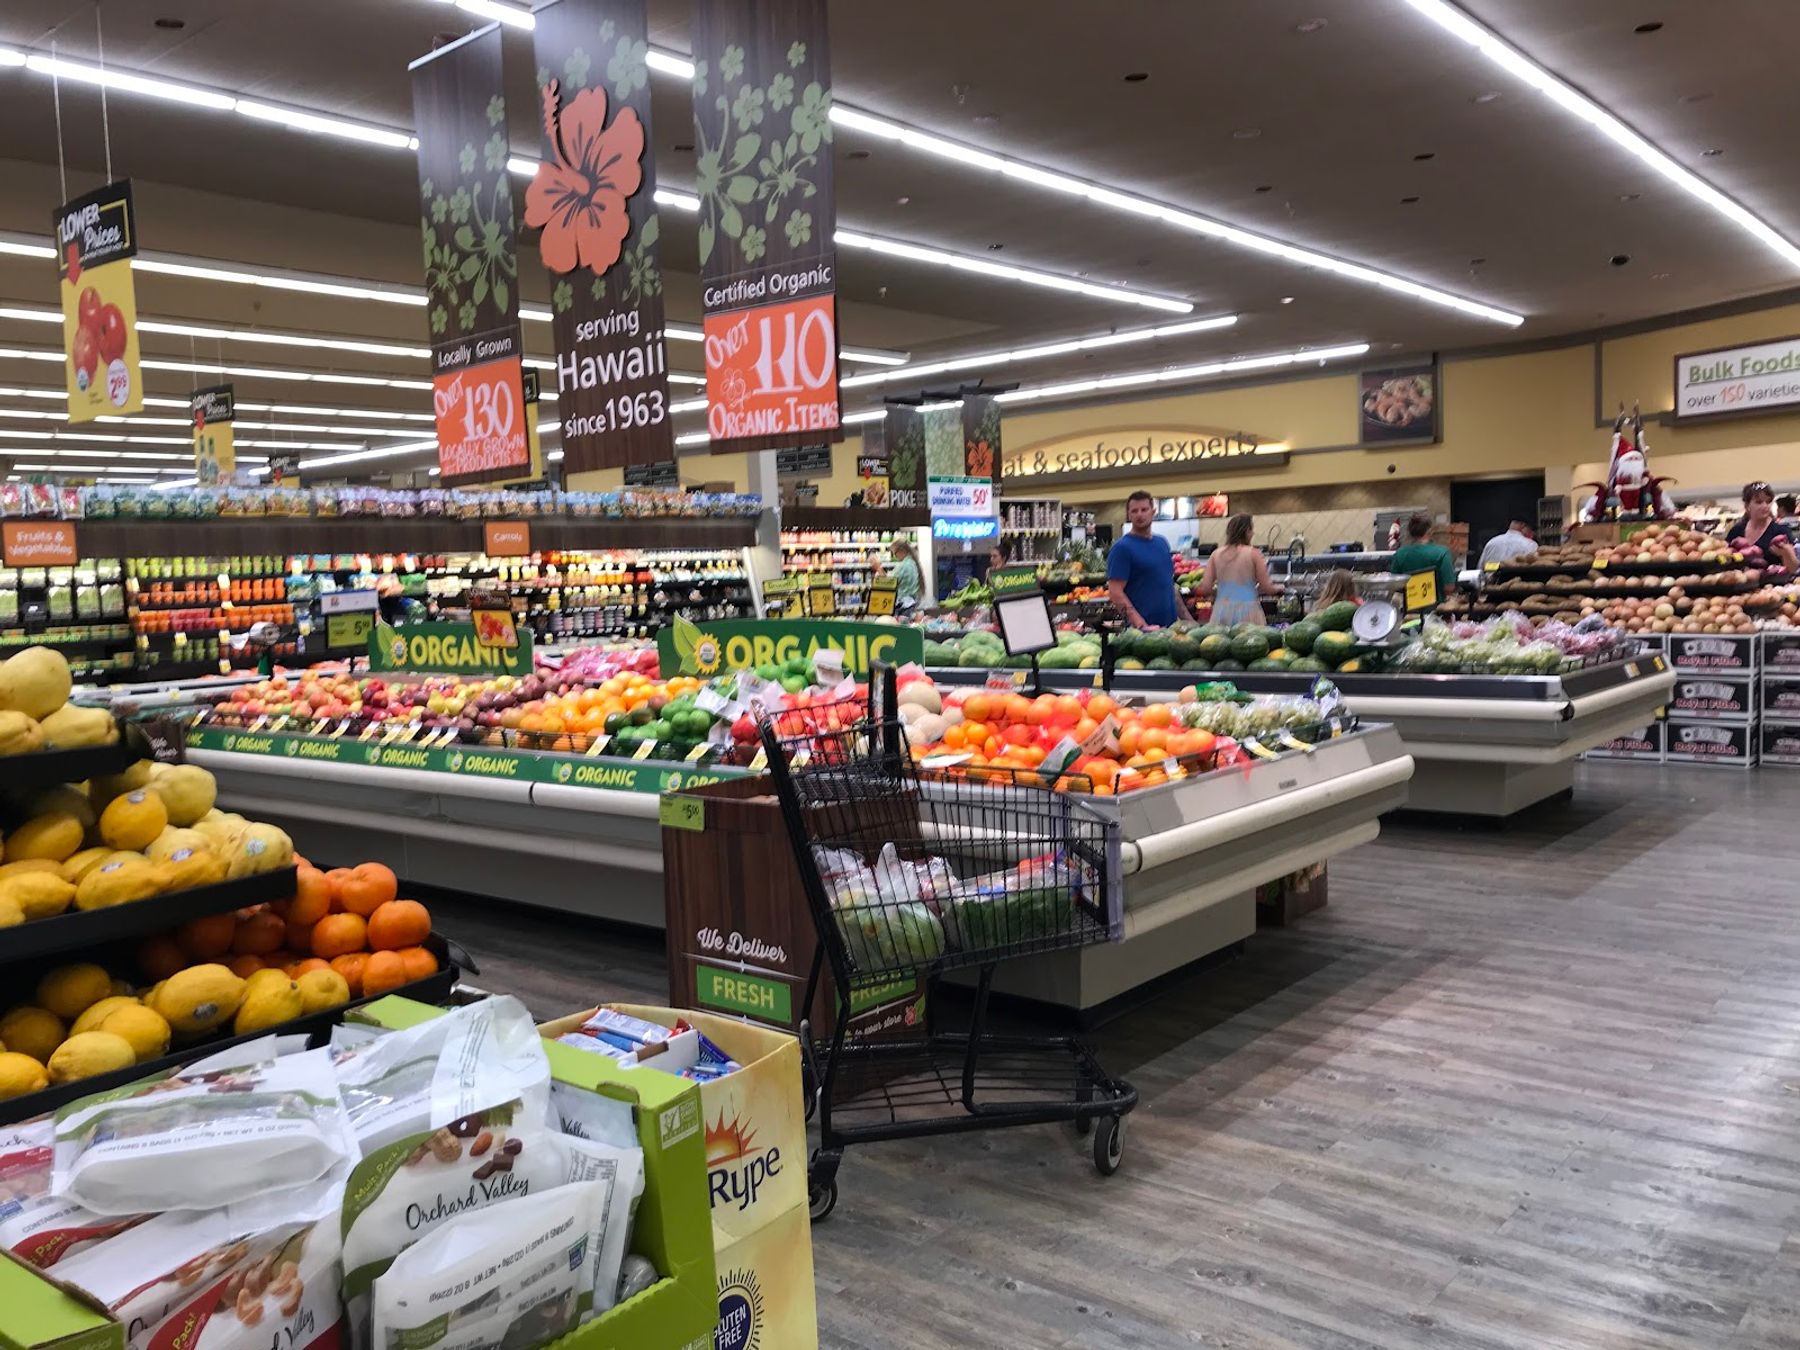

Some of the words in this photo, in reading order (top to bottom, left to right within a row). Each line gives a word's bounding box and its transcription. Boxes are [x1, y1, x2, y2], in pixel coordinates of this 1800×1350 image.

[61, 203, 100, 243] LOWER
[84, 225, 121, 254] Prices
[704, 276, 766, 307] Certified
[769, 264, 832, 295] Organic
[576, 310, 639, 342] serving
[437, 344, 472, 368] Locally
[475, 337, 512, 358] Grown
[557, 330, 665, 394] Hawaii
[1688, 361, 1734, 384] Bulk
[1687, 392, 1717, 409] over
[1719, 383, 1747, 404] 150
[565, 413, 607, 438] since
[605, 390, 665, 432] 1963
[708, 403, 784, 440] ORGANIC
[784, 397, 839, 430] ITEMS
[439, 441, 482, 462] LOCALLY
[482, 434, 525, 451] GROWN
[1033, 450, 1048, 474] &
[1056, 437, 1153, 472] seafood
[1160, 431, 1258, 462] experts
[890, 489, 916, 508] POKE
[8, 543, 73, 557] Vegetables
[16, 531, 52, 542] Fruits
[54, 530, 65, 543] &
[1004, 572, 1036, 587] ORGANIC
[409, 634, 519, 668] ORGANIC
[235, 737, 274, 753] ORGANIC
[299, 741, 340, 759] ORGANIC
[382, 750, 429, 767] ORGANIC
[464, 755, 519, 776] ORGANIC
[575, 766, 637, 787] ORGANIC
[697, 926, 725, 951] We
[726, 931, 787, 963] Deliver
[713, 975, 774, 1009] FRESH
[708, 1147, 780, 1211] Rype
[406, 1184, 480, 1231] Orchard
[480, 1172, 529, 1201] Valley
[22, 1212, 63, 1234] CONTAINS
[35, 1232, 65, 1256] Pack!
[172, 1312, 197, 1350] Pack!
[719, 1323, 742, 1350] FREE
